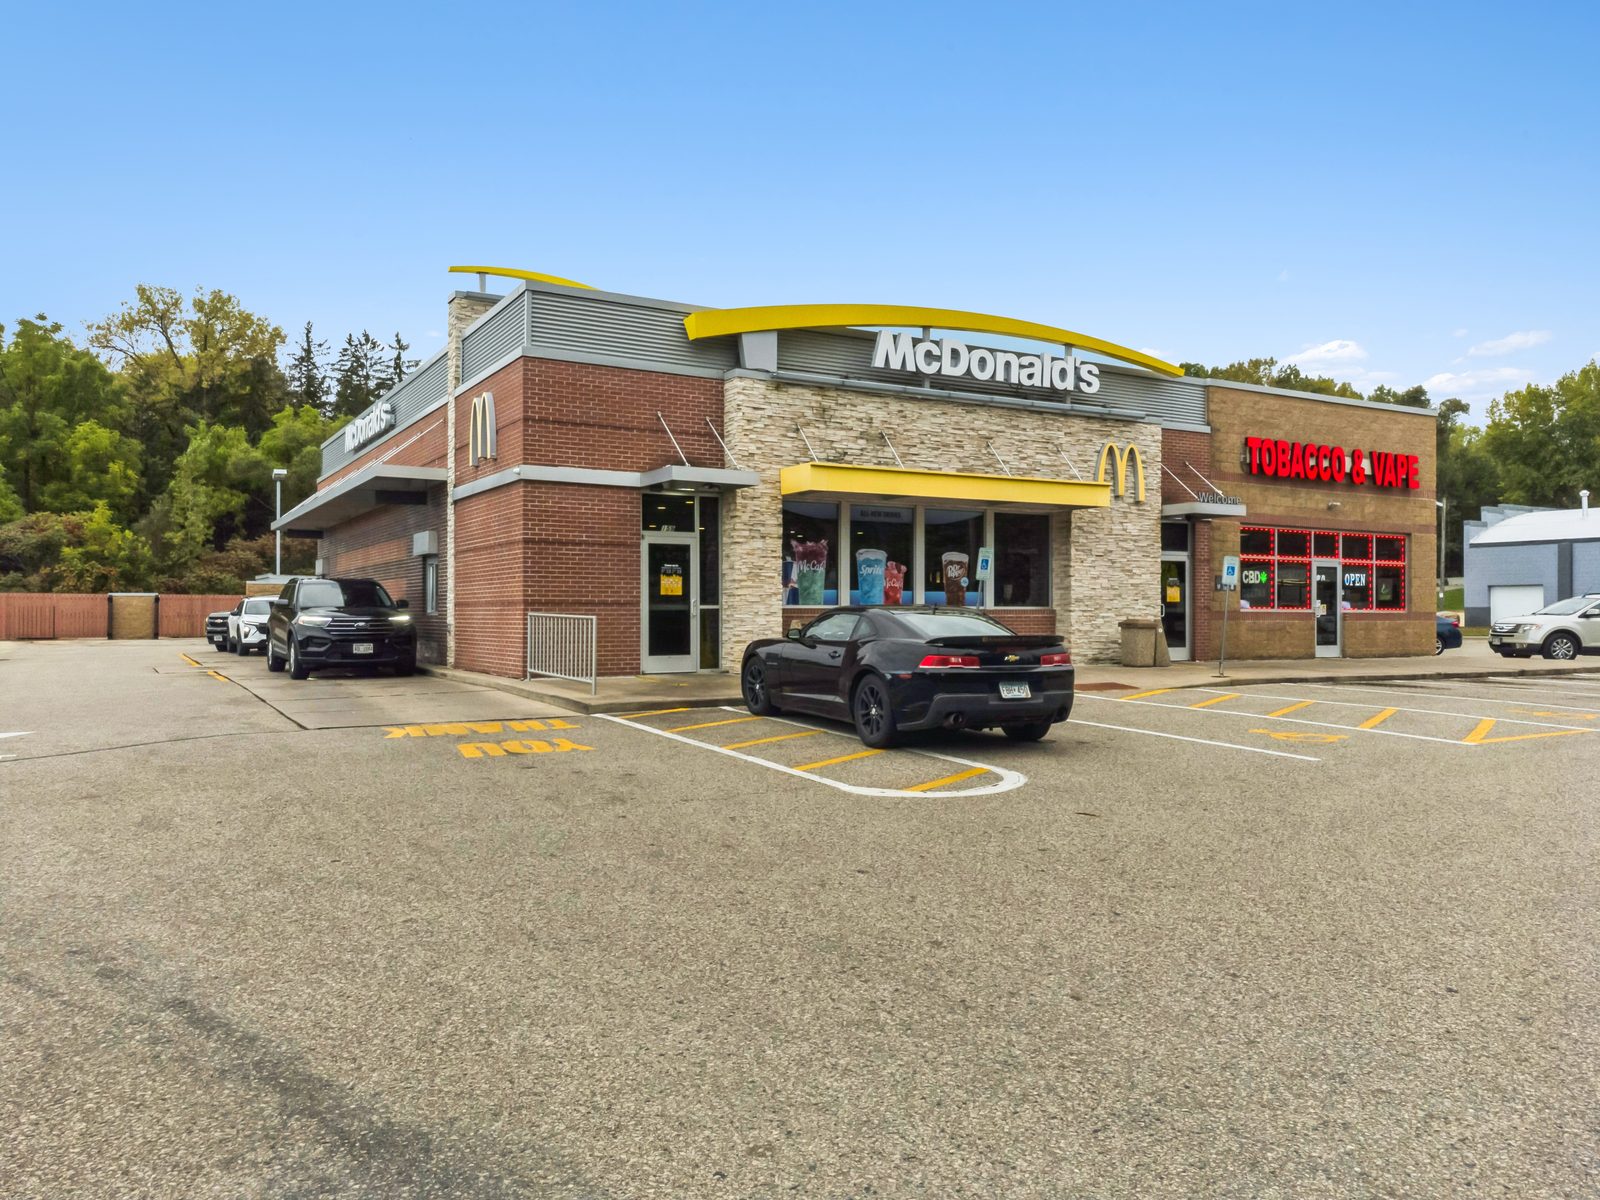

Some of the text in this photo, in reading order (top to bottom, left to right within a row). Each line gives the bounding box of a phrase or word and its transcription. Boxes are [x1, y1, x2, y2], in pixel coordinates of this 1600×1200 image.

[872, 330, 1100, 394] McDonald's
[345, 401, 395, 453] McDonald's
[1245, 436, 1420, 489] TOBACCO & VAPE
[1199, 491, 1242, 504] Welcome
[1242, 570, 1261, 584] CBD
[1344, 573, 1366, 587] OPEN
[384, 719, 581, 738] THANK
[457, 738, 593, 759] YOU
